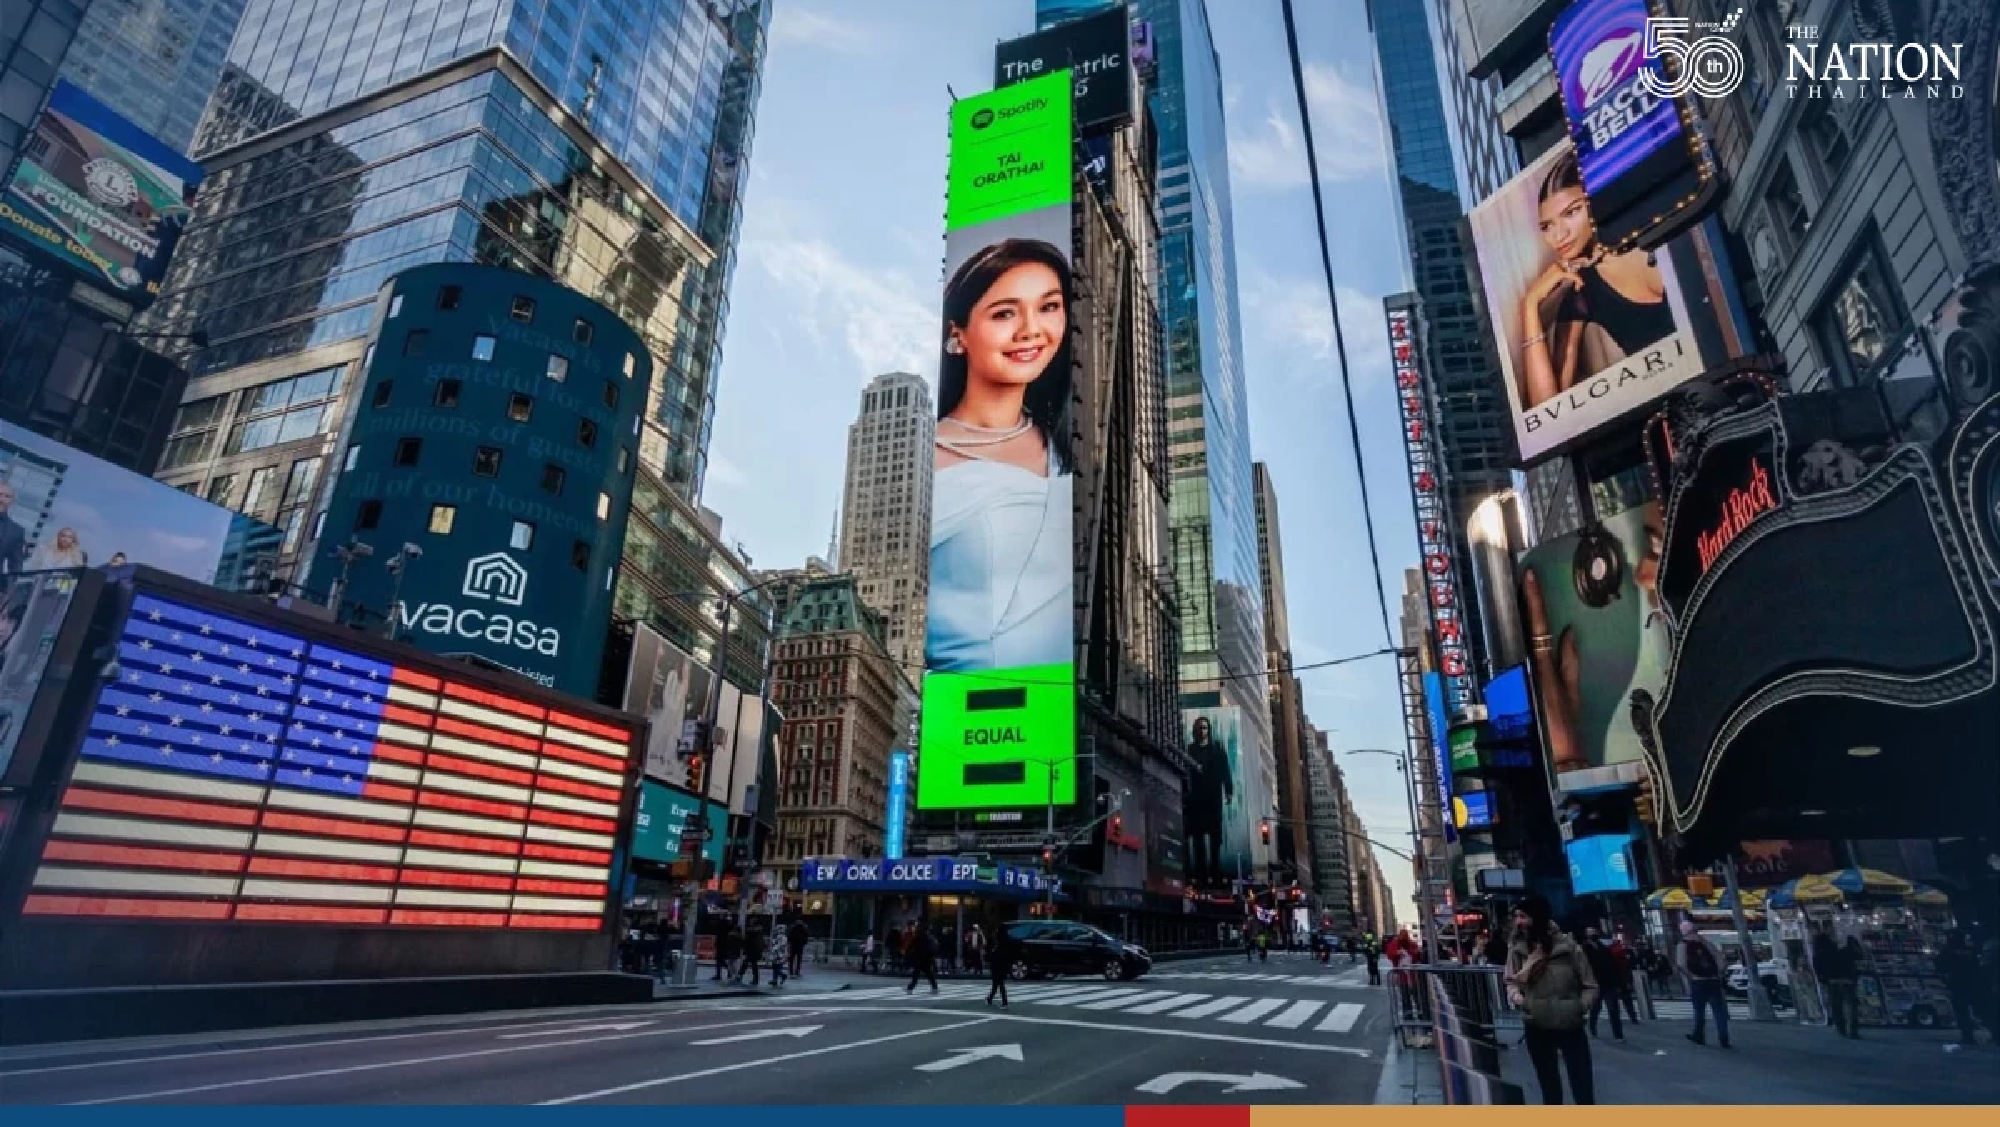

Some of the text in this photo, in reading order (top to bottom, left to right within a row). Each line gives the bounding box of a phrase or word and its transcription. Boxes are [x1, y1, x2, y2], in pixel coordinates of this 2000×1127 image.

[1002, 57, 1044, 79] The
[996, 97, 1049, 119] Spotify
[1582, 76, 1650, 133] TACO
[1592, 95, 1664, 151] BELL
[973, 160, 1045, 188] ORATHAI
[997, 151, 1021, 168] TAI
[32, 185, 157, 259] FOUNDATION
[1524, 338, 1684, 433] BVLGARI
[1697, 457, 1776, 575] Hard Rock
[398, 599, 561, 657] vacasa
[964, 726, 1028, 746] EQUAL
